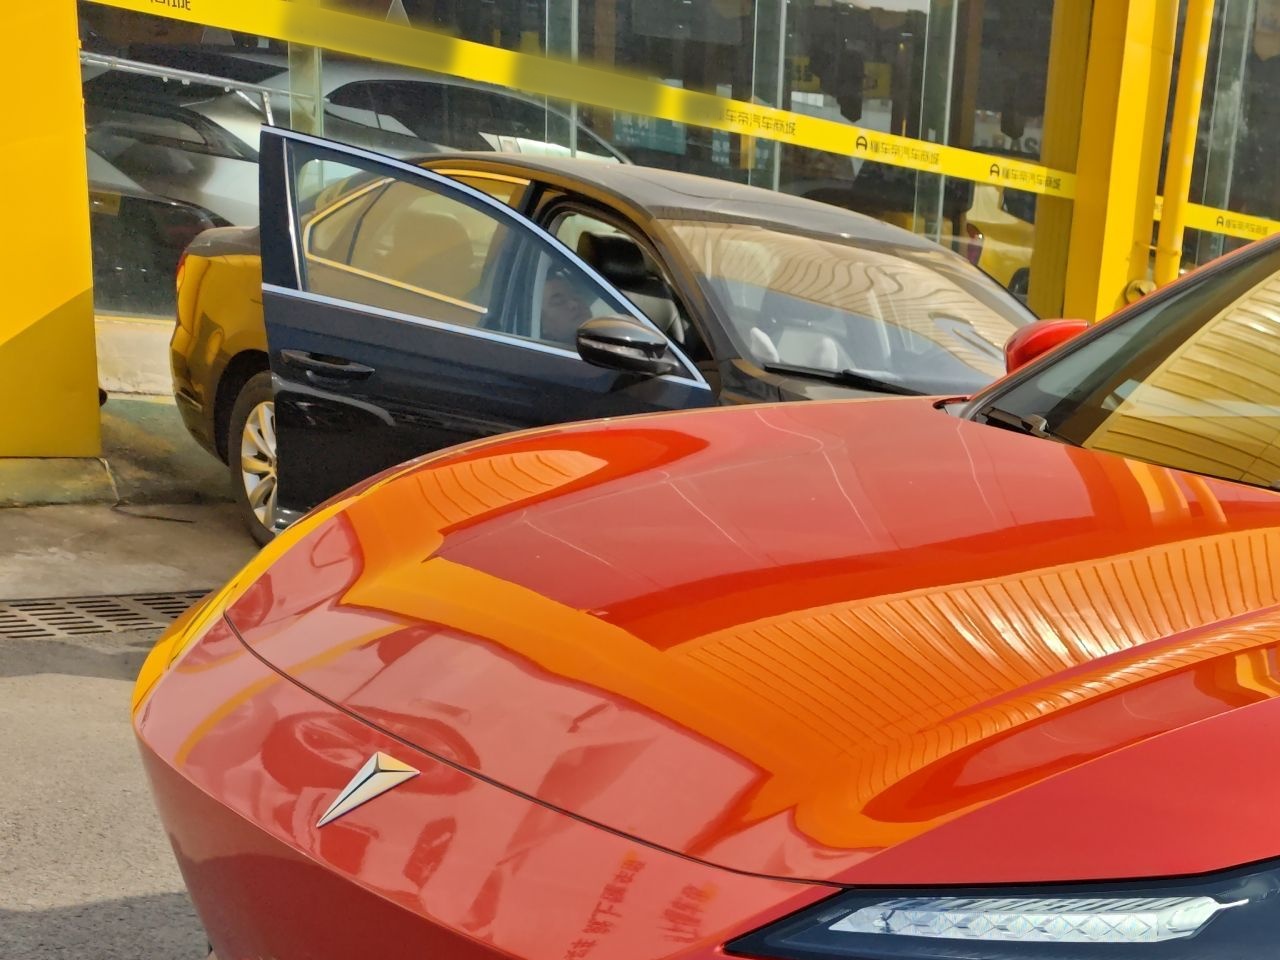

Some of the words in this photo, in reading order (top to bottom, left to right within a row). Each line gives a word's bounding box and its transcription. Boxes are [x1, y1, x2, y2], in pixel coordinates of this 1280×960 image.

[718, 107, 796, 136] 车帝汽车商城
